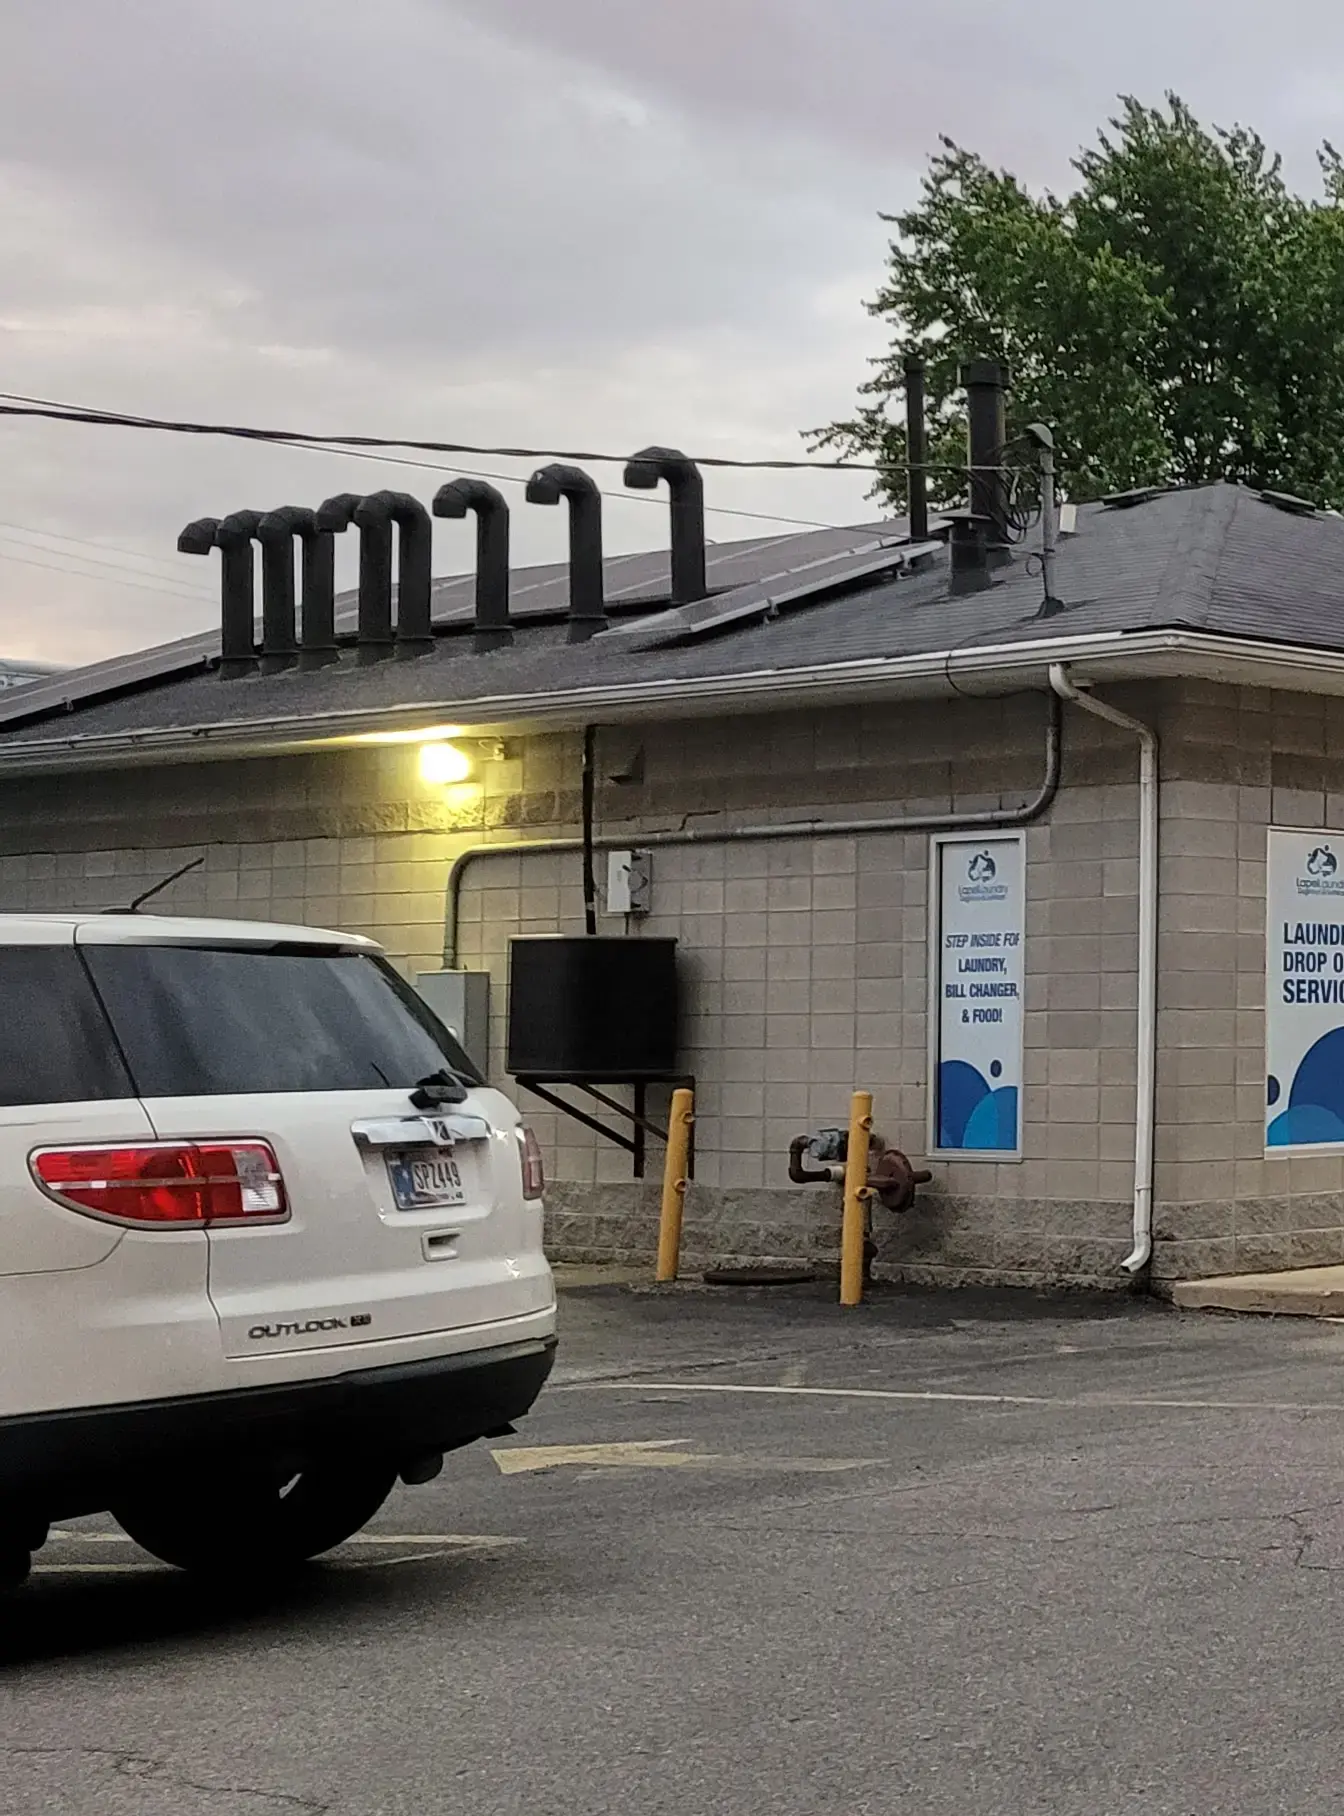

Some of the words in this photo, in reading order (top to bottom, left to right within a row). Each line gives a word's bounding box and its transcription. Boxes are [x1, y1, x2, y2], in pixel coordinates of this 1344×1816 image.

[945, 934, 968, 948] STEP
[970, 932, 1001, 947] INSIDE
[958, 957, 1008, 975] LAUNDRY,
[1283, 951, 1328, 973] DROP
[945, 983, 966, 998] BILL
[962, 1008, 969, 1023] &
[973, 1008, 1003, 1023] FOOD!
[414, 1161, 462, 1190] SPZ449
[247, 1317, 348, 1339] OUTLOOK
